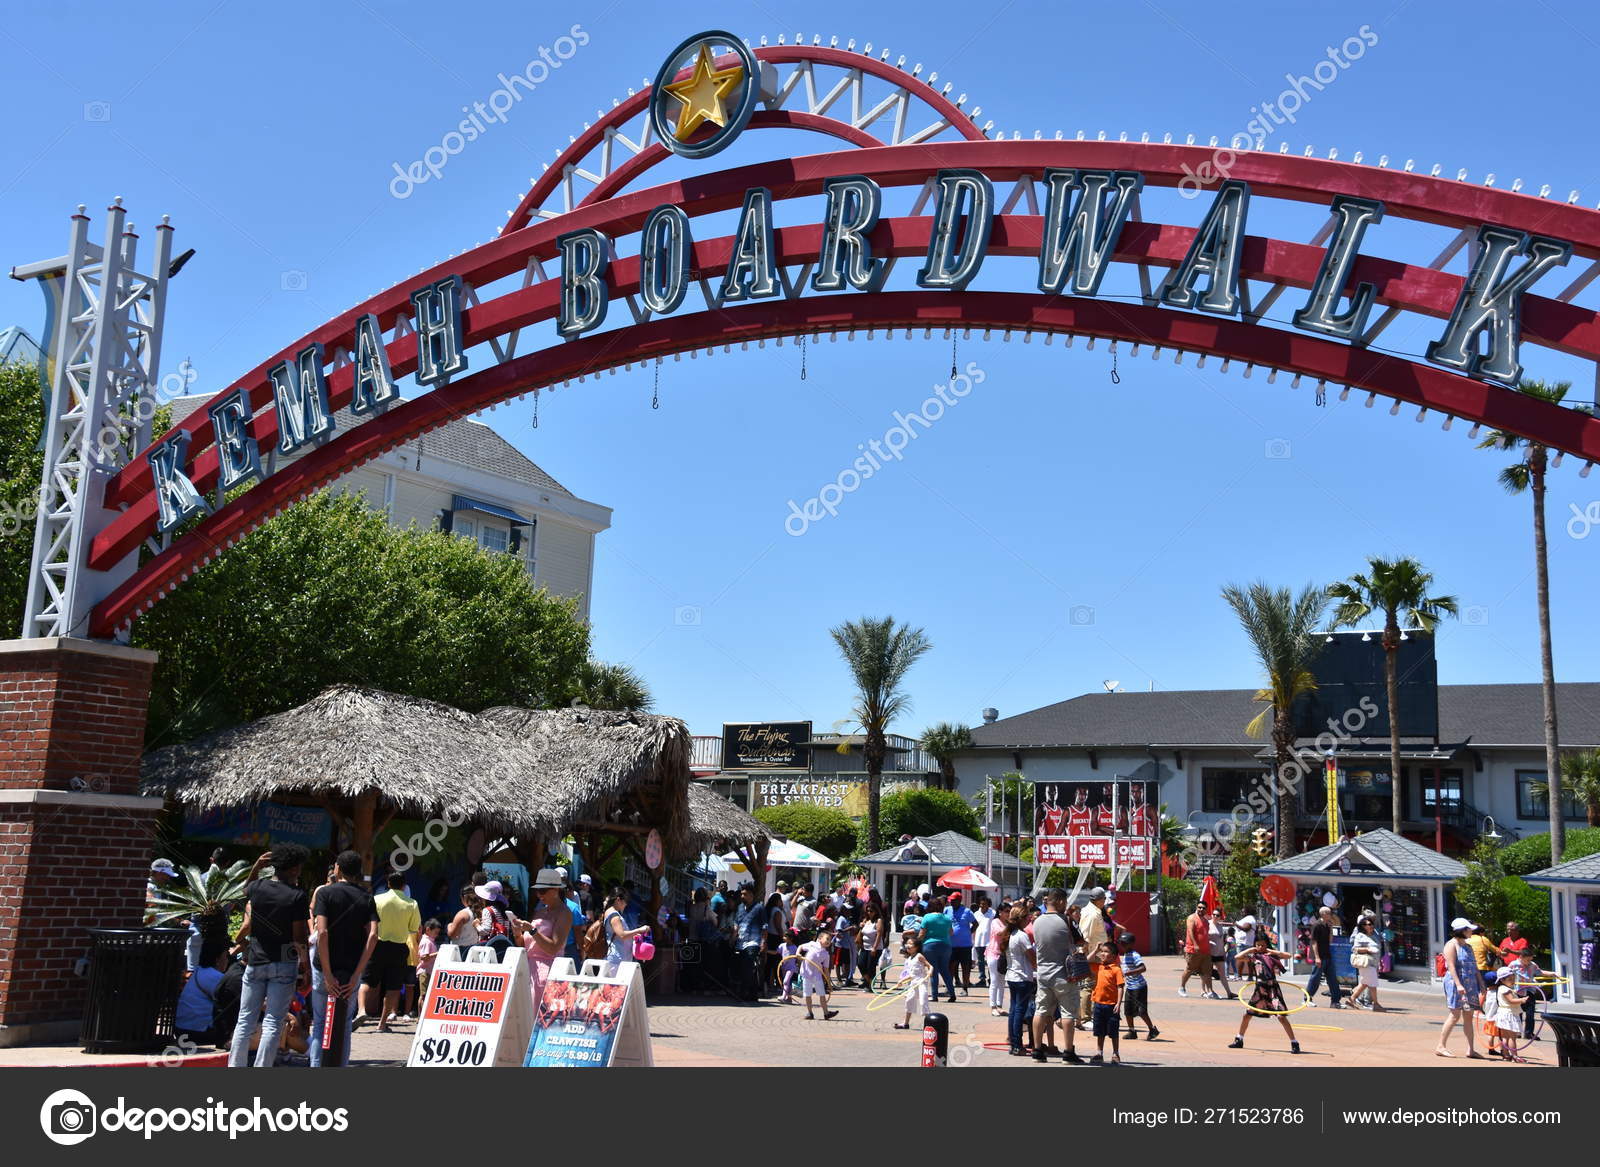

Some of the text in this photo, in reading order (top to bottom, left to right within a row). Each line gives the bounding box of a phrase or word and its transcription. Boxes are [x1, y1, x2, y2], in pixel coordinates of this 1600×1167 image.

[146, 167, 1572, 533] KEMAH BOARDWALK
[738, 725, 755, 742] The
[760, 784, 849, 795] BREAKFAST
[763, 796, 777, 806] IS
[1042, 843, 1065, 854] ONE
[1080, 843, 1104, 854] ONE
[1119, 845, 1144, 856] ONE
[435, 970, 504, 993] Premium
[433, 996, 495, 1019] Parking
[439, 1023, 479, 1036] CASH ONLY
[564, 1024, 586, 1034] ADD
[545, 1036, 598, 1048] CRAWFISH
[419, 1037, 487, 1066] $9.00
[923, 1047, 934, 1056] NO
